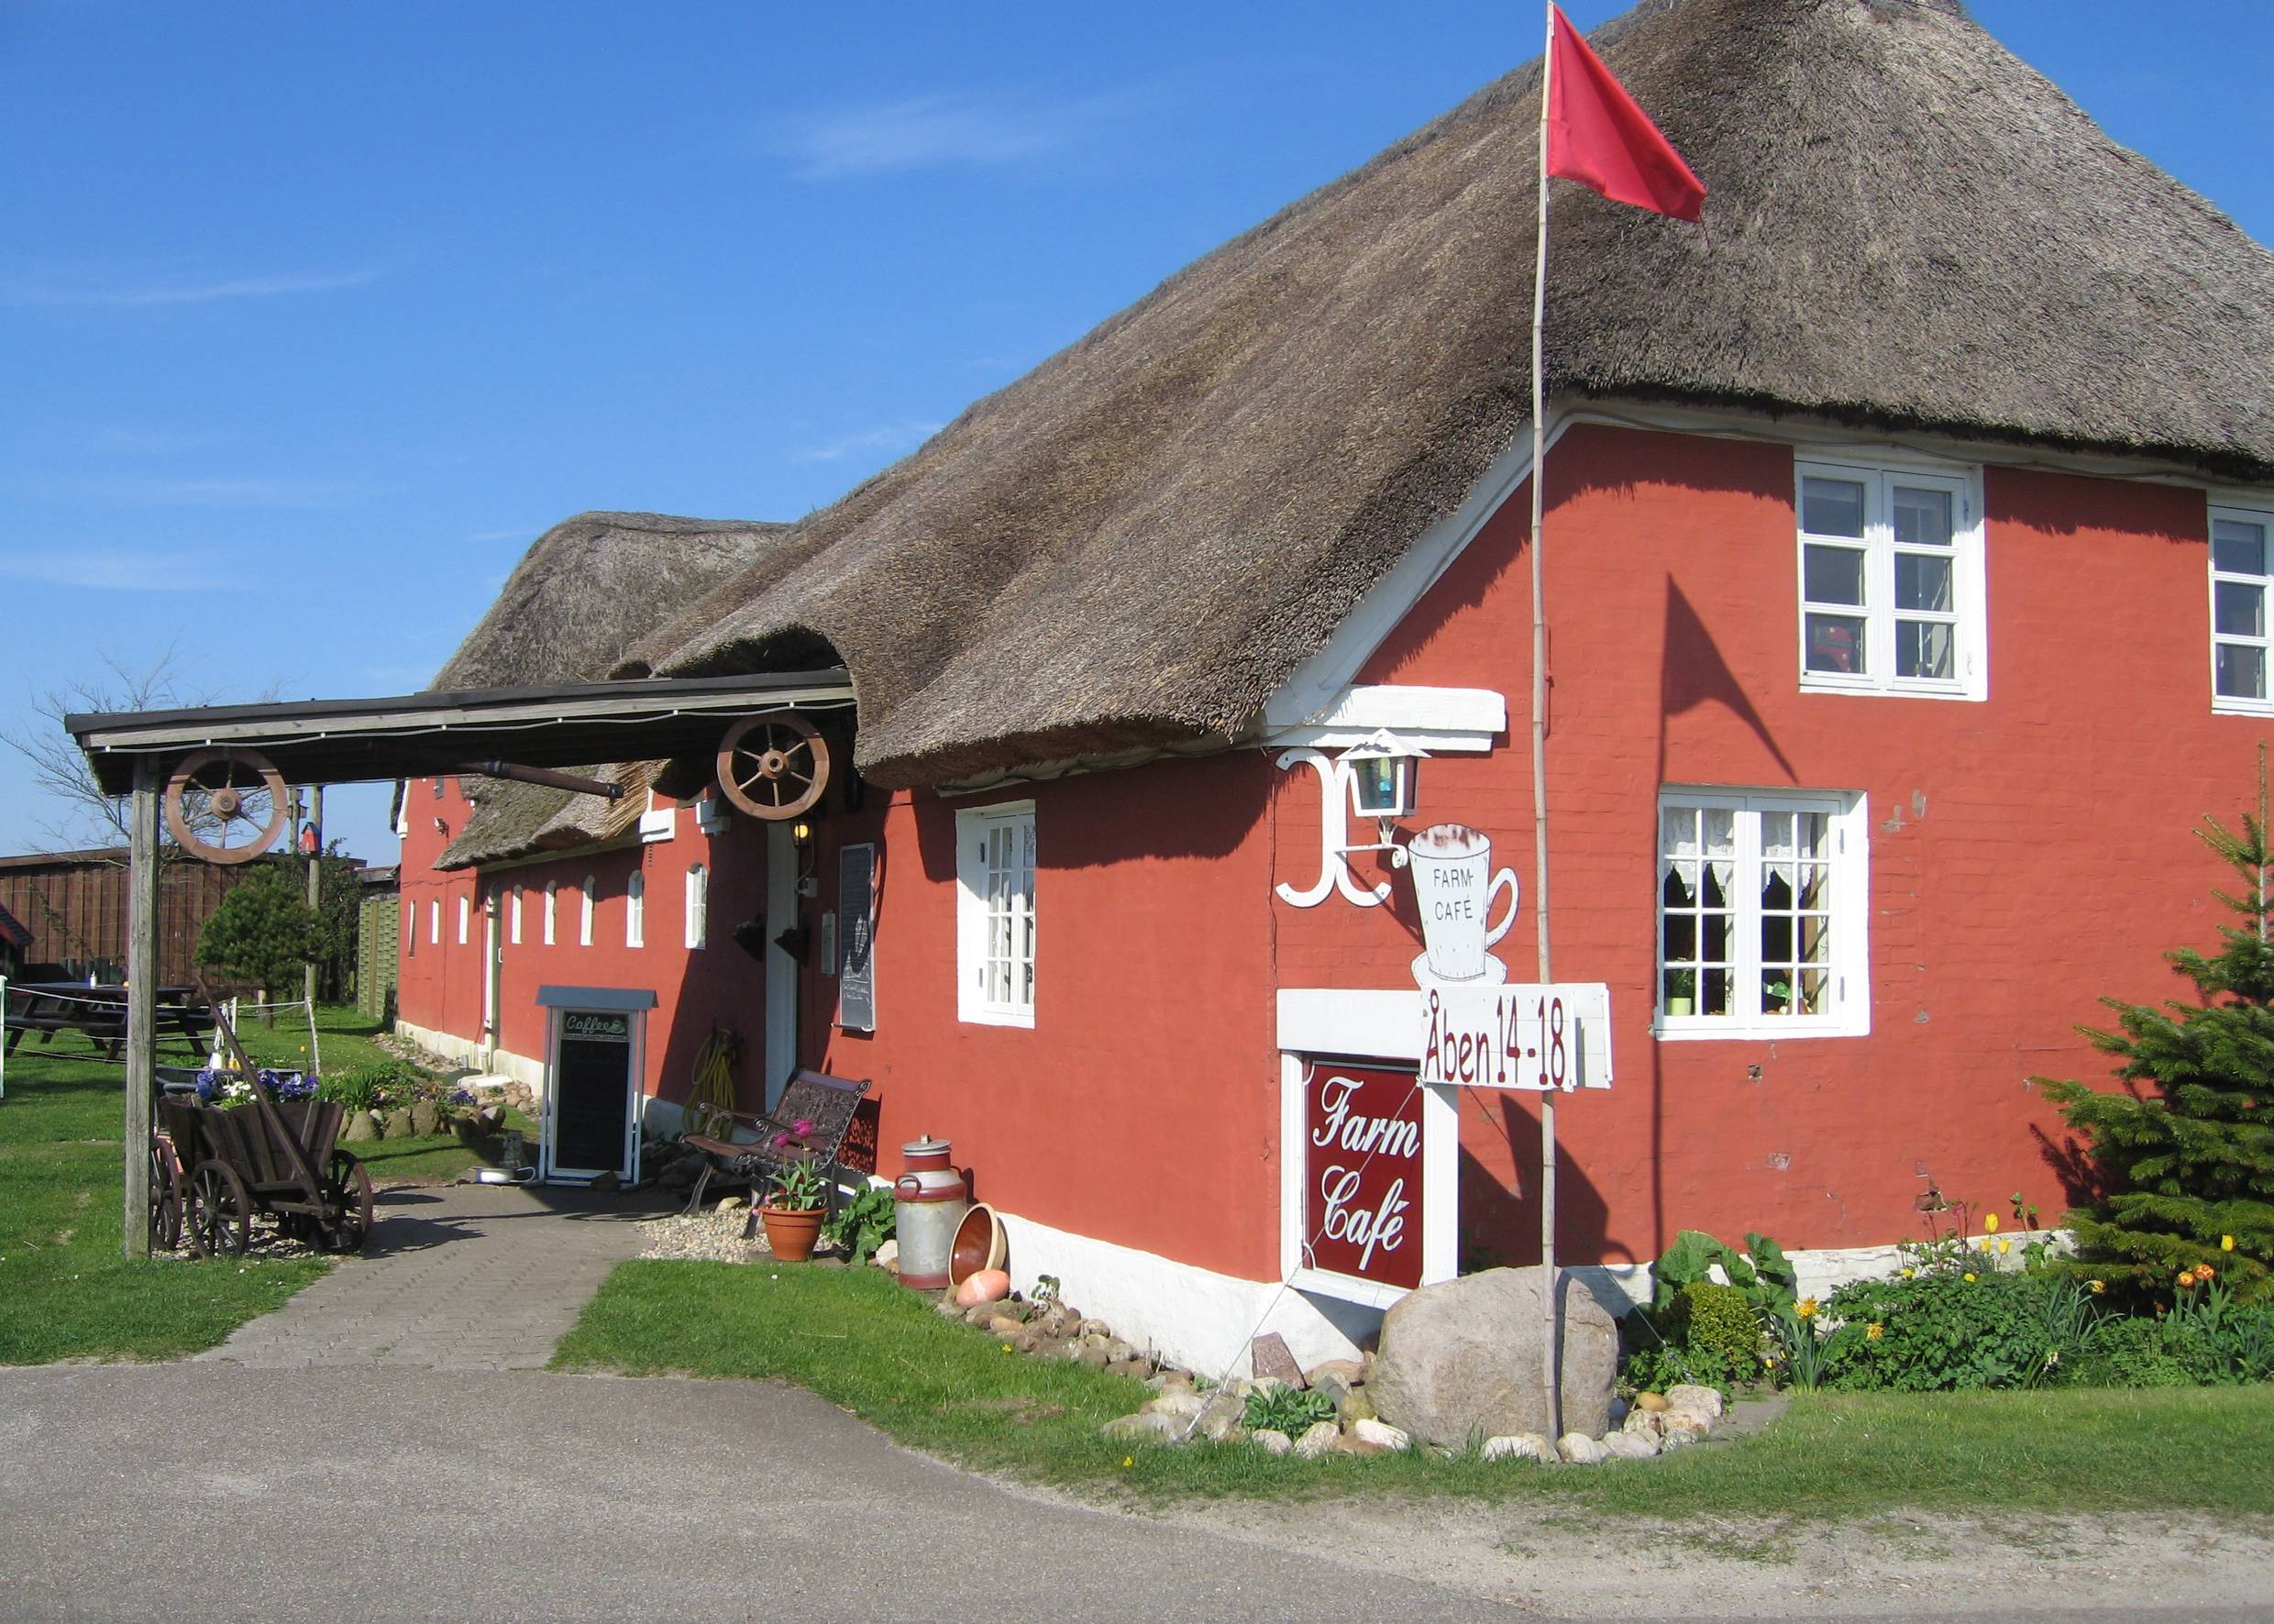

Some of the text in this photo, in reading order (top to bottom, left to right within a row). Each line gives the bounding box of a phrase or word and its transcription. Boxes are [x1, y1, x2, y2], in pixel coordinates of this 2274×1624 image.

[1435, 894, 1474, 922] CAFÉ
[566, 1015, 610, 1034] Coffee
[1424, 989, 1490, 1084] Åben
[1312, 1076, 1420, 1159] Farm
[1320, 1165, 1410, 1271] Café
